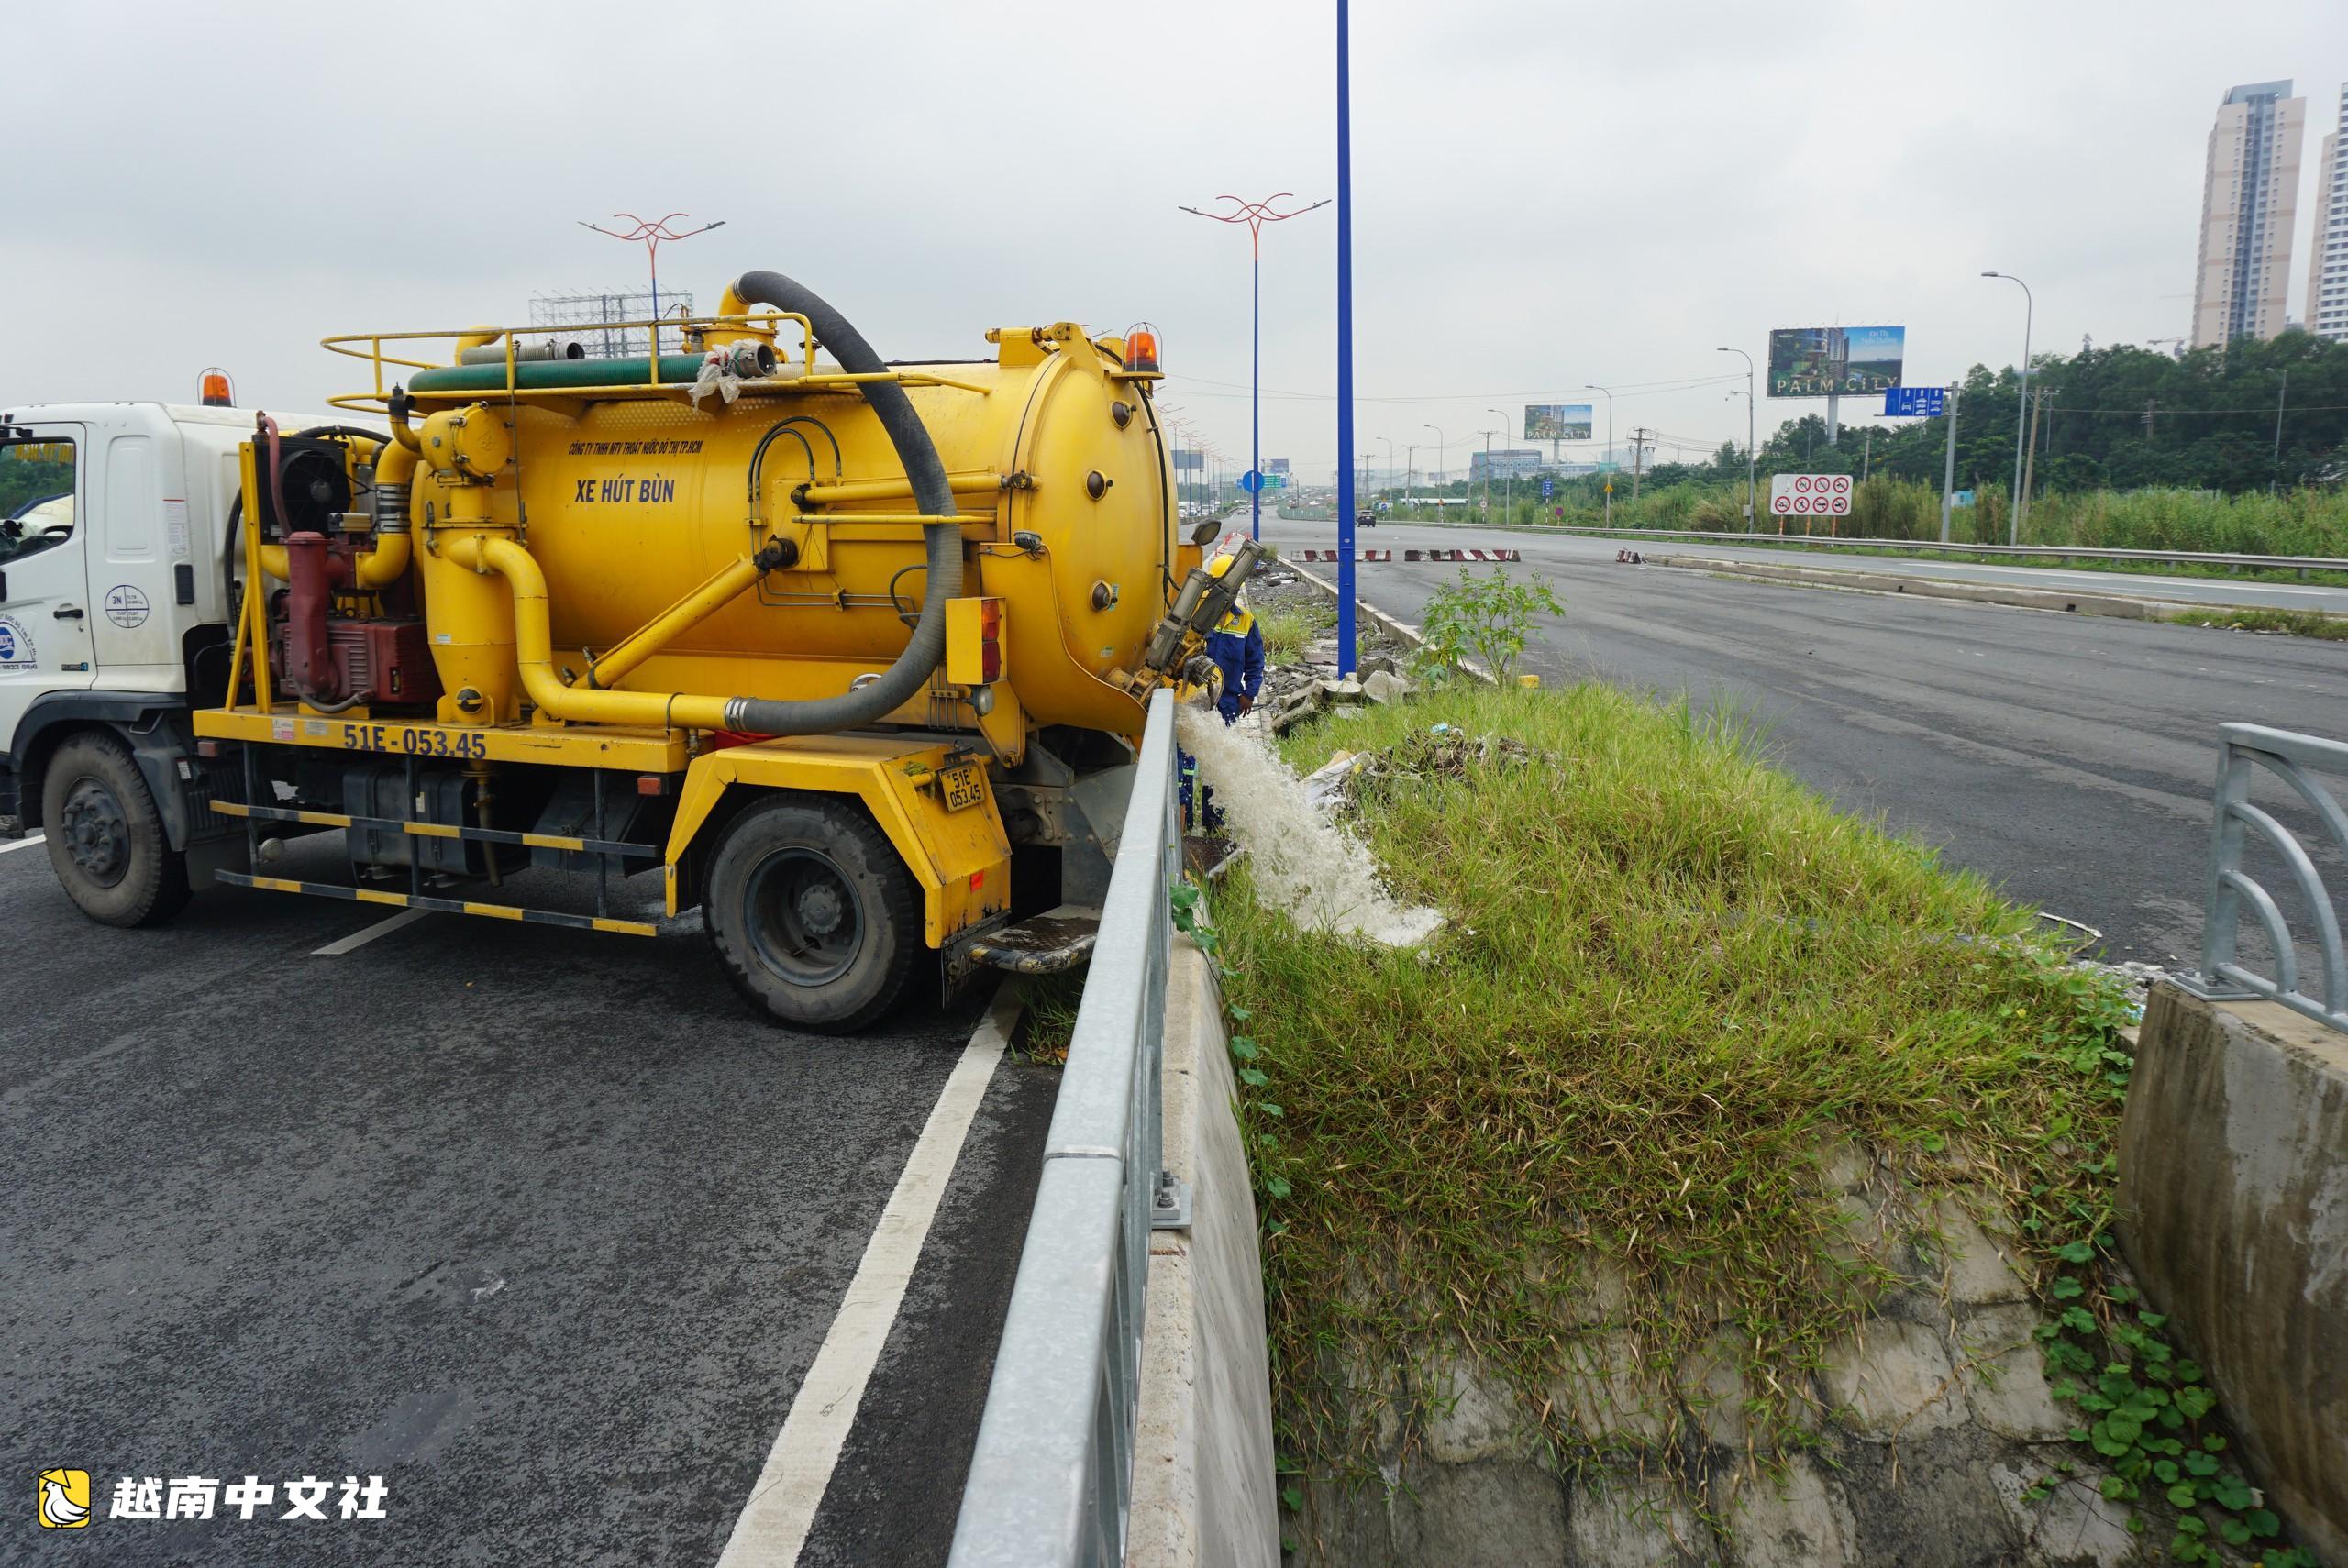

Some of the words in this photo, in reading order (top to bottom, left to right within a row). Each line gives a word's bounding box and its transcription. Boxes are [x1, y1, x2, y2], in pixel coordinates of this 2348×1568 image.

[1777, 378, 1833, 393] PALM
[1846, 377, 1898, 391] CITY
[1527, 431, 1556, 439] PALM
[1563, 430, 1589, 438] CITY
[569, 439, 586, 455] CÔNG
[585, 442, 595, 455] TY
[593, 441, 611, 455] TNHH
[609, 441, 624, 455] MTV
[679, 440, 703, 454] TP.HCM
[575, 480, 596, 502] XE
[601, 473, 635, 502] HÚT
[638, 473, 675, 503] BÙN
[112, 595, 122, 605] 3N
[951, 769, 971, 789] 51E
[949, 784, 981, 808] 053.45
